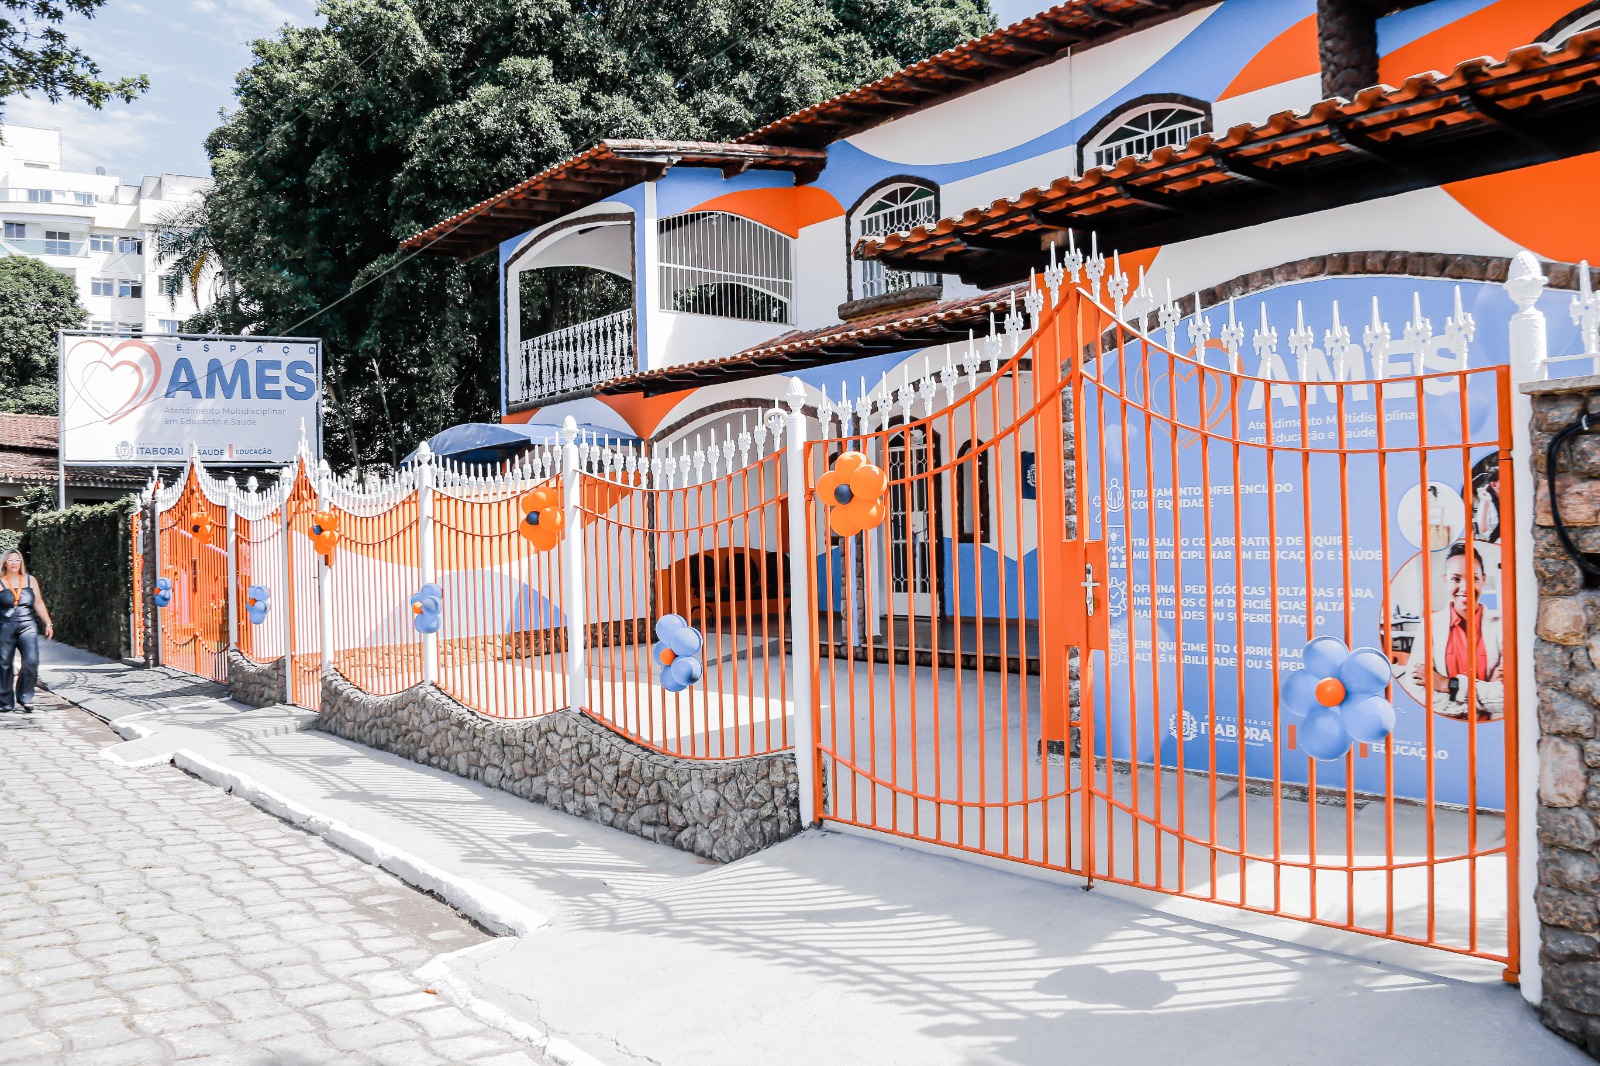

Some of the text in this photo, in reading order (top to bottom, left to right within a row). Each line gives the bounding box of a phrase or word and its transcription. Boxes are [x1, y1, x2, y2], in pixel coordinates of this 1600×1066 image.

[177, 344, 315, 356] ESPAÇO
[165, 358, 315, 400] AMES
[1248, 334, 1472, 410] AMES
[223, 407, 286, 416] Multidisciplinar
[181, 418, 220, 427] Educação
[1248, 410, 1418, 430] Atedimeto Mltidisplina
[1248, 435, 1266, 444] em
[1271, 430, 1325, 443] Educaão
[1345, 427, 1376, 438] aúde
[1131, 487, 1201, 498] TRAAMNTO
[1131, 498, 1213, 510] CO EQIDADE
[1132, 538, 1189, 547] TRABALO
[1192, 536, 1282, 547] COABORATIVO
[1286, 536, 1303, 546] DE
[1255, 550, 1323, 562] EDCAÇO
[1327, 551, 1335, 560] E
[1134, 584, 1176, 594] OFIINA
[1185, 583, 1266, 595] PEDGÓCAS
[1270, 587, 1334, 597] OLTAAS
[1134, 595, 1196, 607] INDÍDOS
[1198, 598, 1224, 608] CM
[1227, 598, 1307, 611] DFICIÊCIAS
[1134, 609, 1205, 620] HALIDDES
[1227, 612, 1325, 627] SPERDOTAÇO
[1135, 640, 1230, 653] ENQUCIMETO
[1135, 653, 1166, 663] ALTS
[1169, 654, 1239, 667] HBILIADE
[1200, 721, 1273, 742] IABORA
[1372, 743, 1449, 760] EUCAÇO
